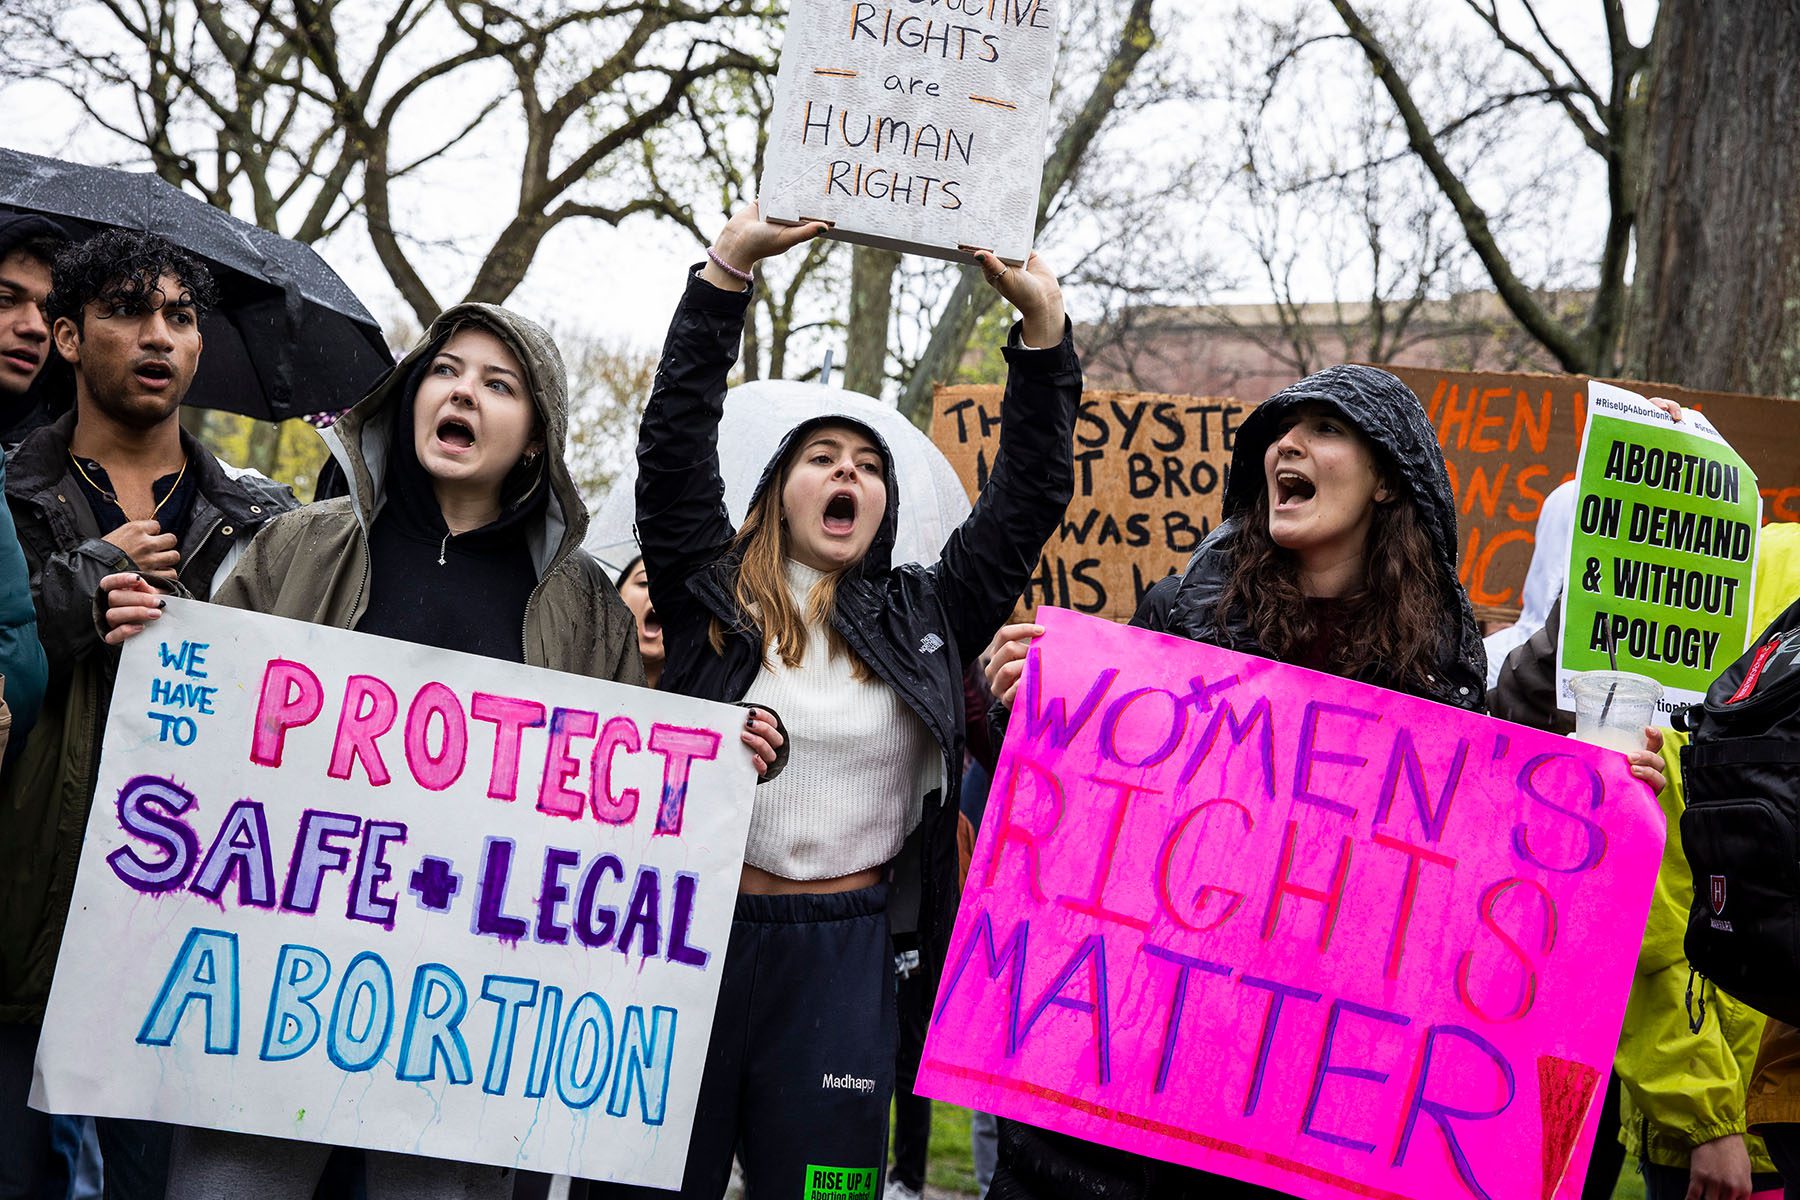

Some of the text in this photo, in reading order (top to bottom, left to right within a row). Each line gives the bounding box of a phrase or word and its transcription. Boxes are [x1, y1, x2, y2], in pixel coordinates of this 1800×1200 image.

[850, 3, 999, 63] RIGHTS
[884, 74, 940, 97] are
[802, 101, 974, 166] HUMAN
[825, 160, 962, 210] RIGHTS
[944, 399, 1244, 452] TH SYSTE
[1595, 397, 1673, 422] #RiseUp4AbortionR
[1127, 453, 1231, 500] BRO
[1604, 439, 1740, 504] ABORTION
[1060, 508, 1150, 548] WAS
[1580, 494, 1624, 540] ON
[1629, 503, 1752, 563] DEMAND
[1023, 553, 1107, 614] HIS
[1582, 556, 1601, 593] &
[1613, 557, 1740, 617] WITHOUT
[158, 640, 210, 678] WE
[1590, 611, 1722, 672] APOLOGY
[150, 678, 218, 715] HAVE
[147, 711, 198, 747] TO
[249, 657, 723, 837] PROTECT
[1025, 647, 1608, 874] WOMEN'S
[105, 774, 408, 930] SAFE
[470, 835, 712, 972] LEGAL
[983, 755, 1559, 1025] RIGHTS
[1713, 881, 1722, 902] H
[136, 926, 678, 1127] ABORTION
[822, 1073, 876, 1093] Madhappy
[812, 1170, 873, 1191] RISE UP 4
